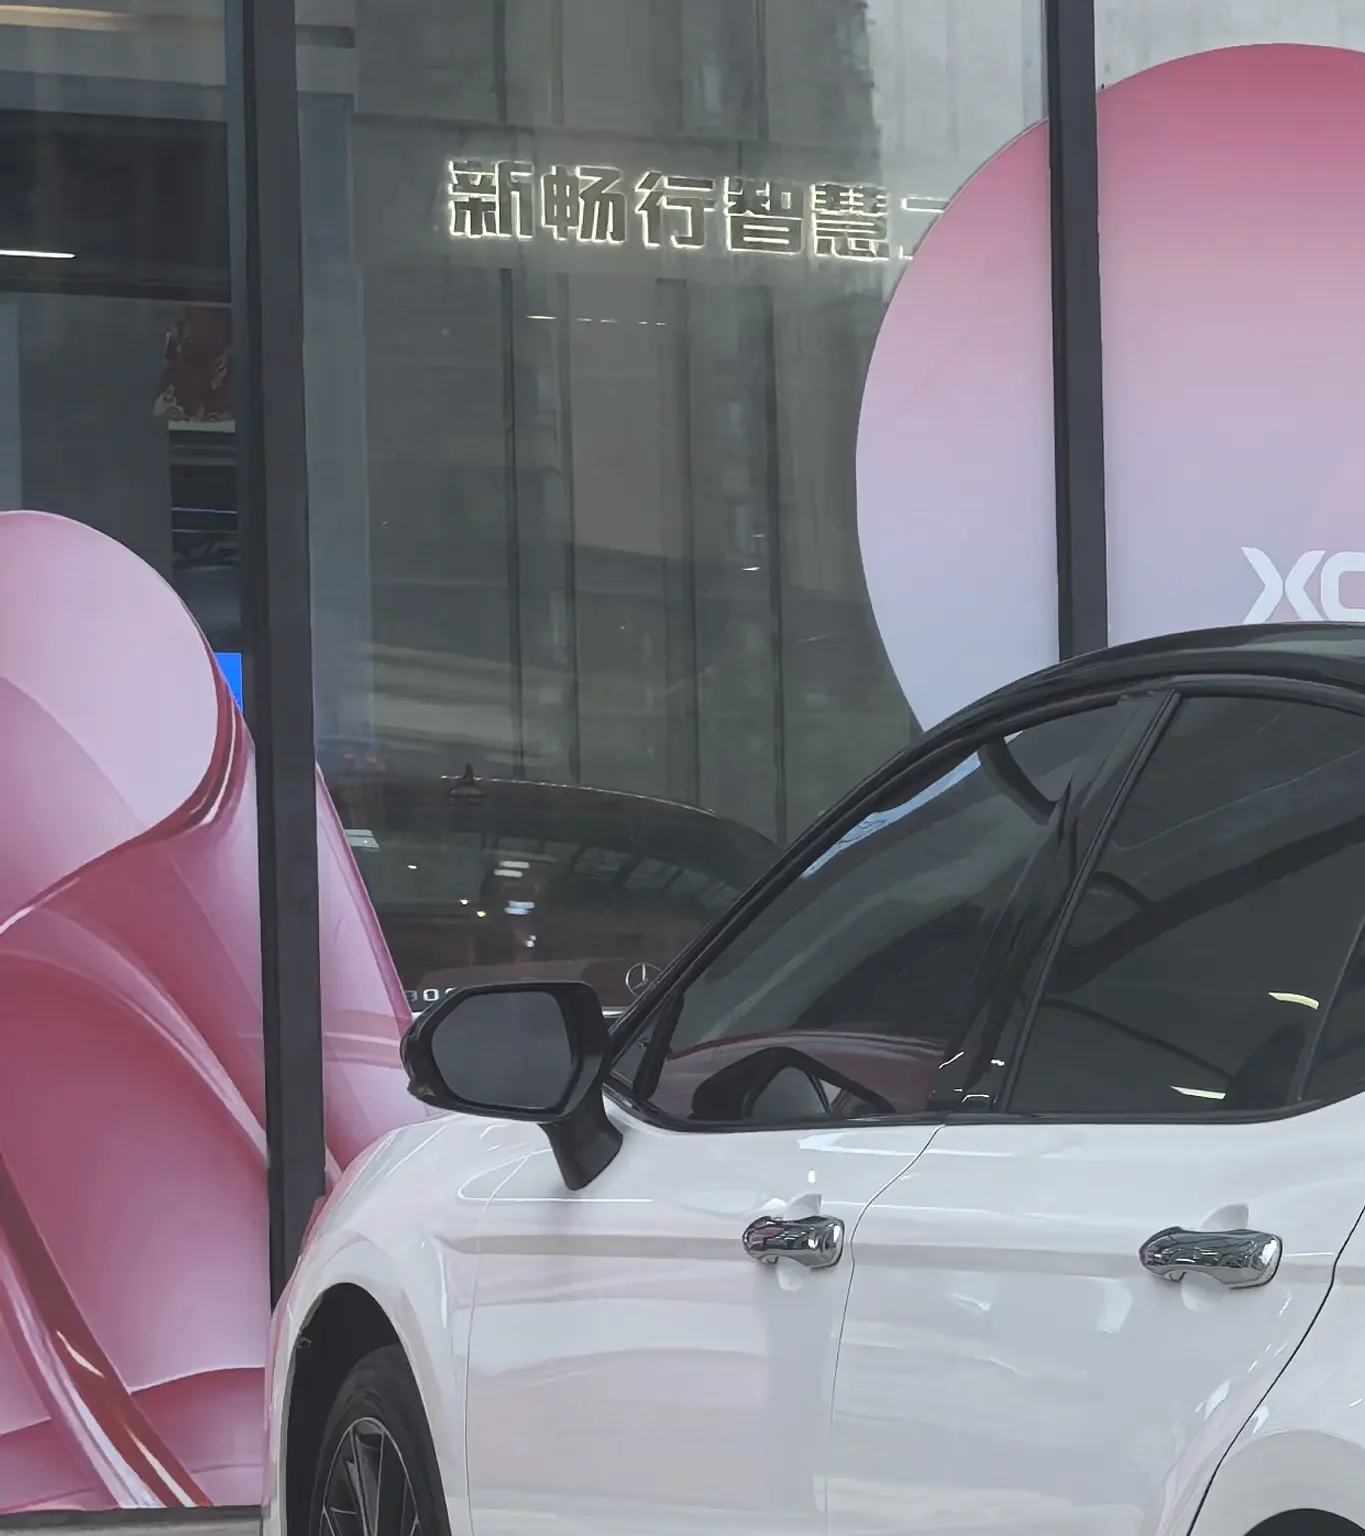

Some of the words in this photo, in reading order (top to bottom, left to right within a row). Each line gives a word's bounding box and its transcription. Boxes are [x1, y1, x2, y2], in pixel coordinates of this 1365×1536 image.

[444, 158, 947, 262] 新畅行智慧
